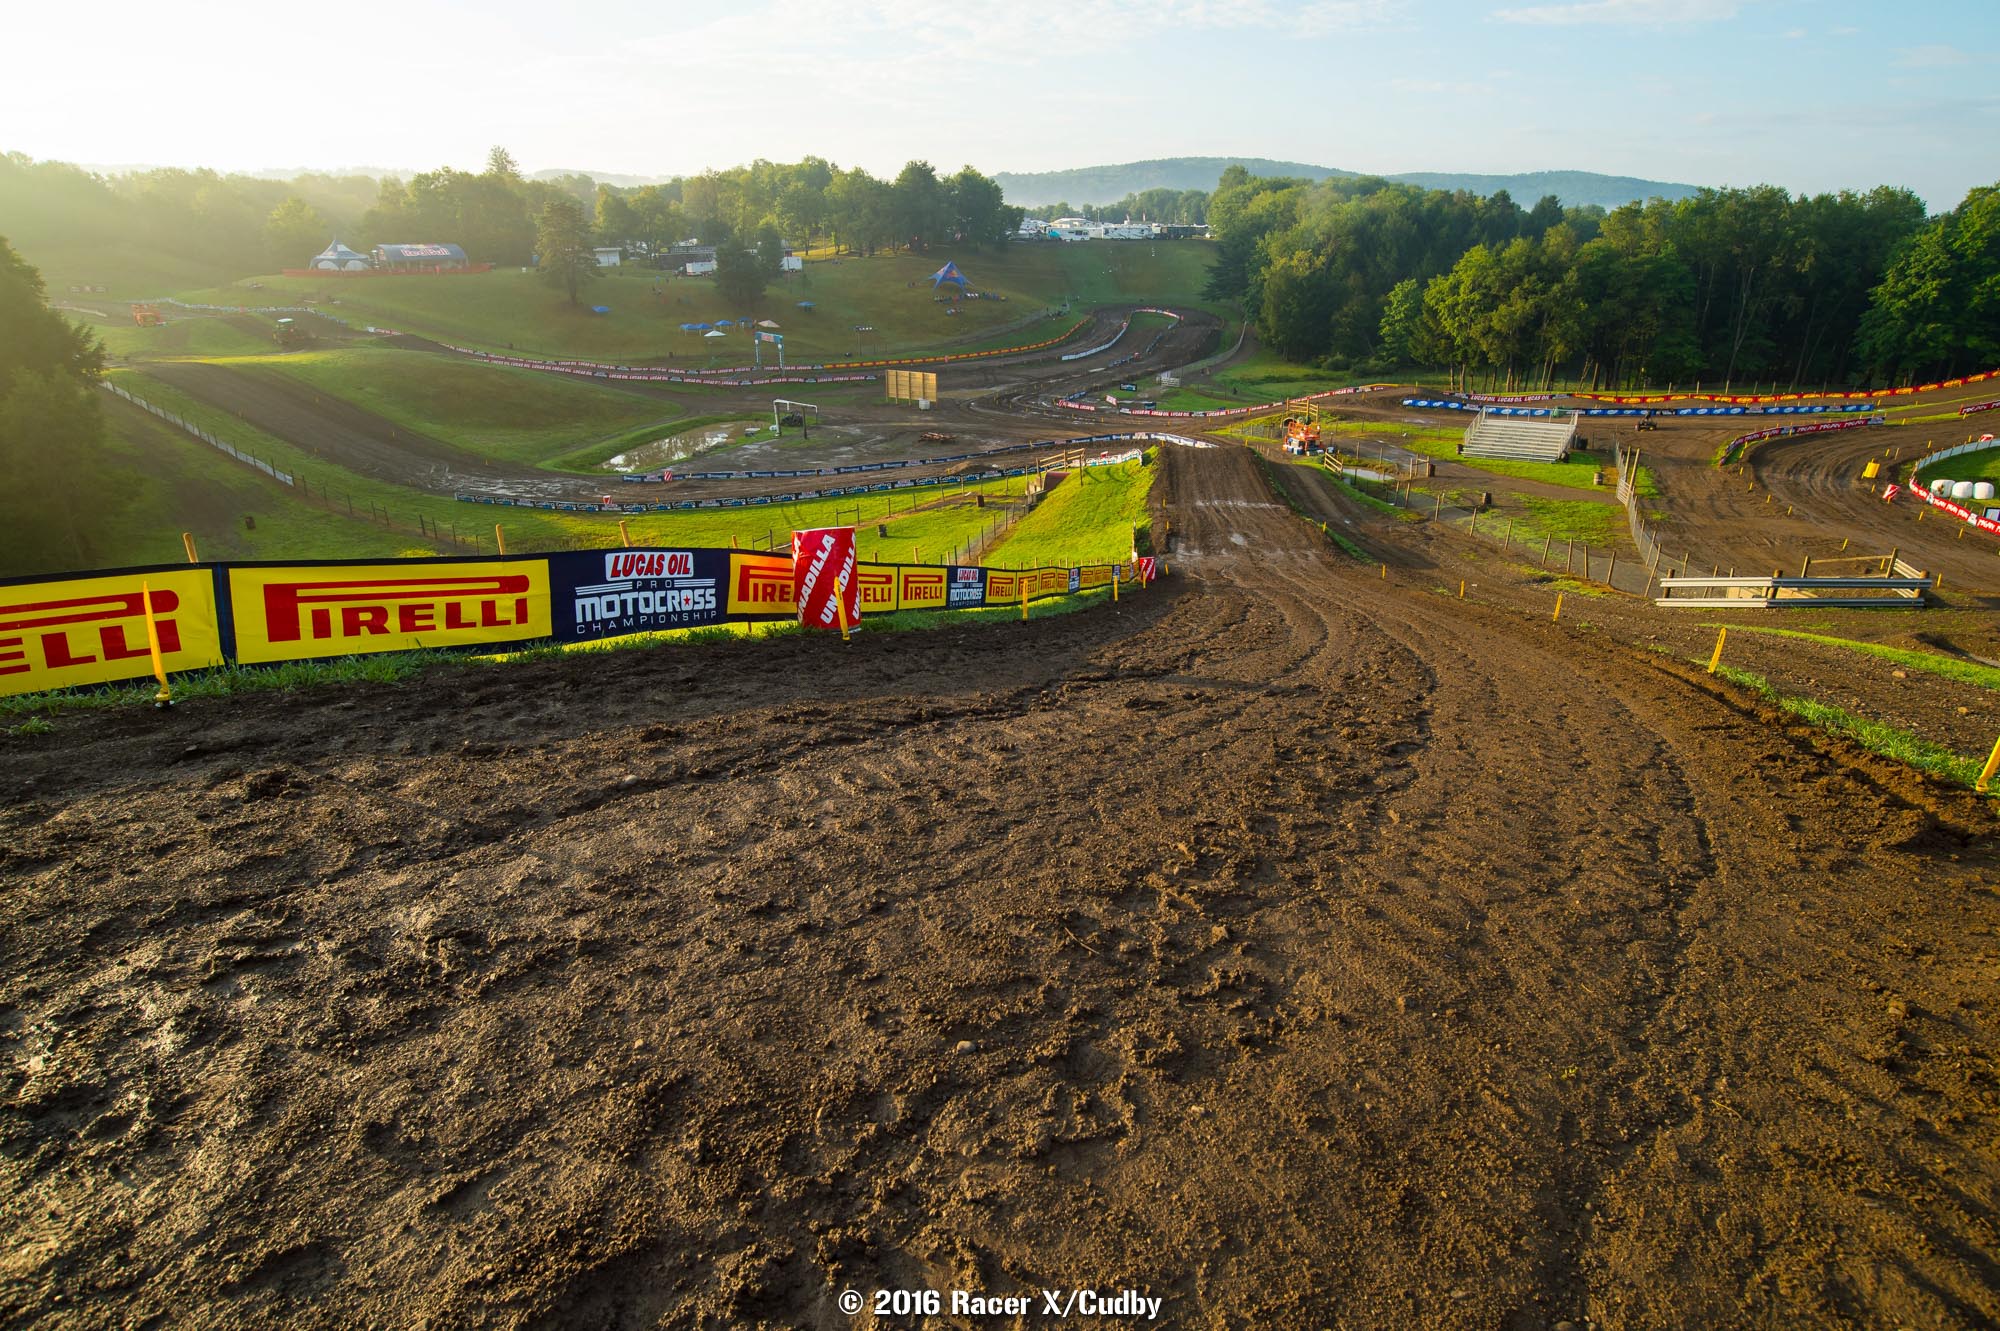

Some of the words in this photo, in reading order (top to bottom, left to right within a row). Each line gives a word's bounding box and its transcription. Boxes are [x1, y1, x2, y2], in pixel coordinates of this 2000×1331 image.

[610, 553, 665, 577] LUCAS
[667, 554, 691, 575] OIL
[636, 580, 672, 589] PRO
[903, 574, 943, 601] PIRELLI
[950, 588, 983, 601] MOTOCROSS
[988, 576, 1014, 597] PIRELLI
[263, 574, 530, 642] PIRELLI
[575, 588, 716, 623] MOTOCROSS
[576, 611, 717, 634] CHAMPIONSHIP
